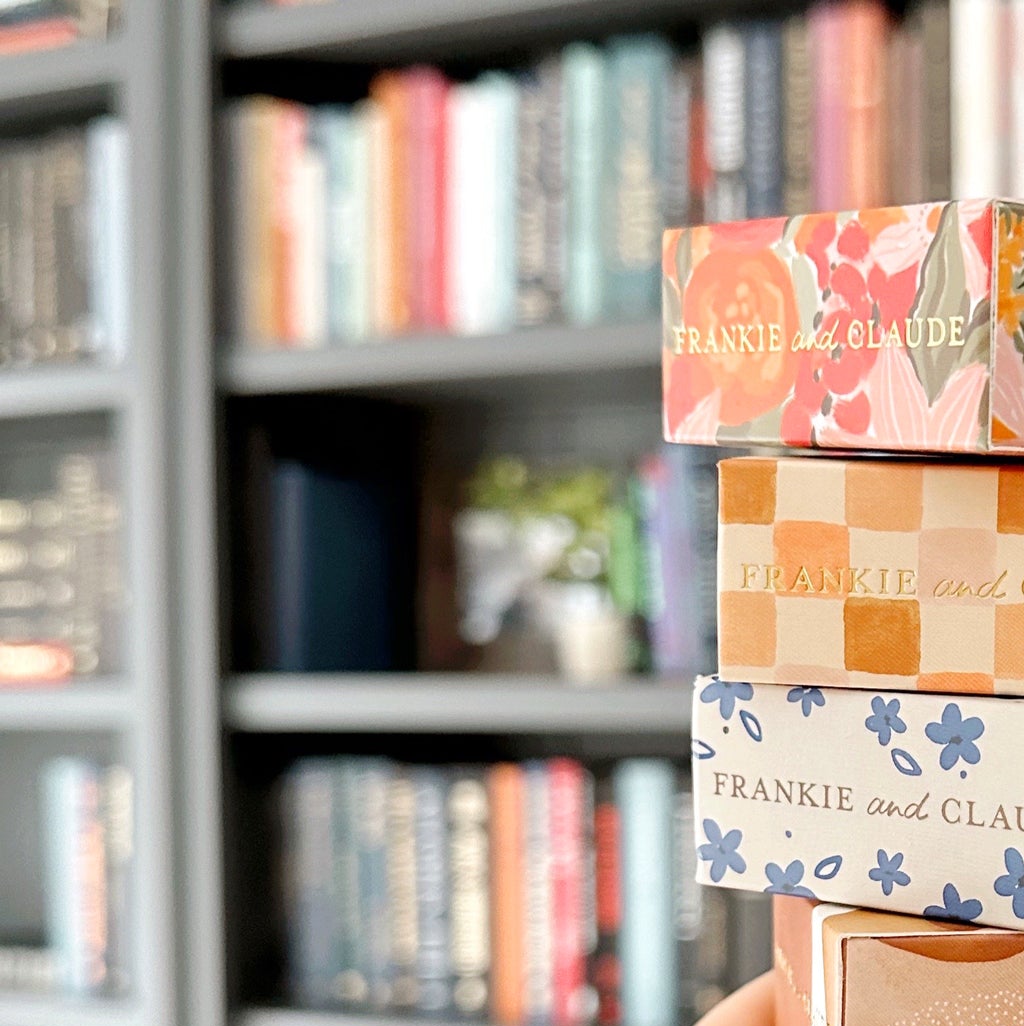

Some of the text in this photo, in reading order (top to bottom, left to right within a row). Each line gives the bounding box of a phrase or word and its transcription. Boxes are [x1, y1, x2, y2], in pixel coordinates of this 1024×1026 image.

[672, 315, 966, 355] FRANKIE and CLAUDE
[740, 563, 917, 596] FRANKIE
[932, 569, 1007, 600] and
[713, 771, 854, 812] FRANKIE
[866, 792, 930, 821] and
